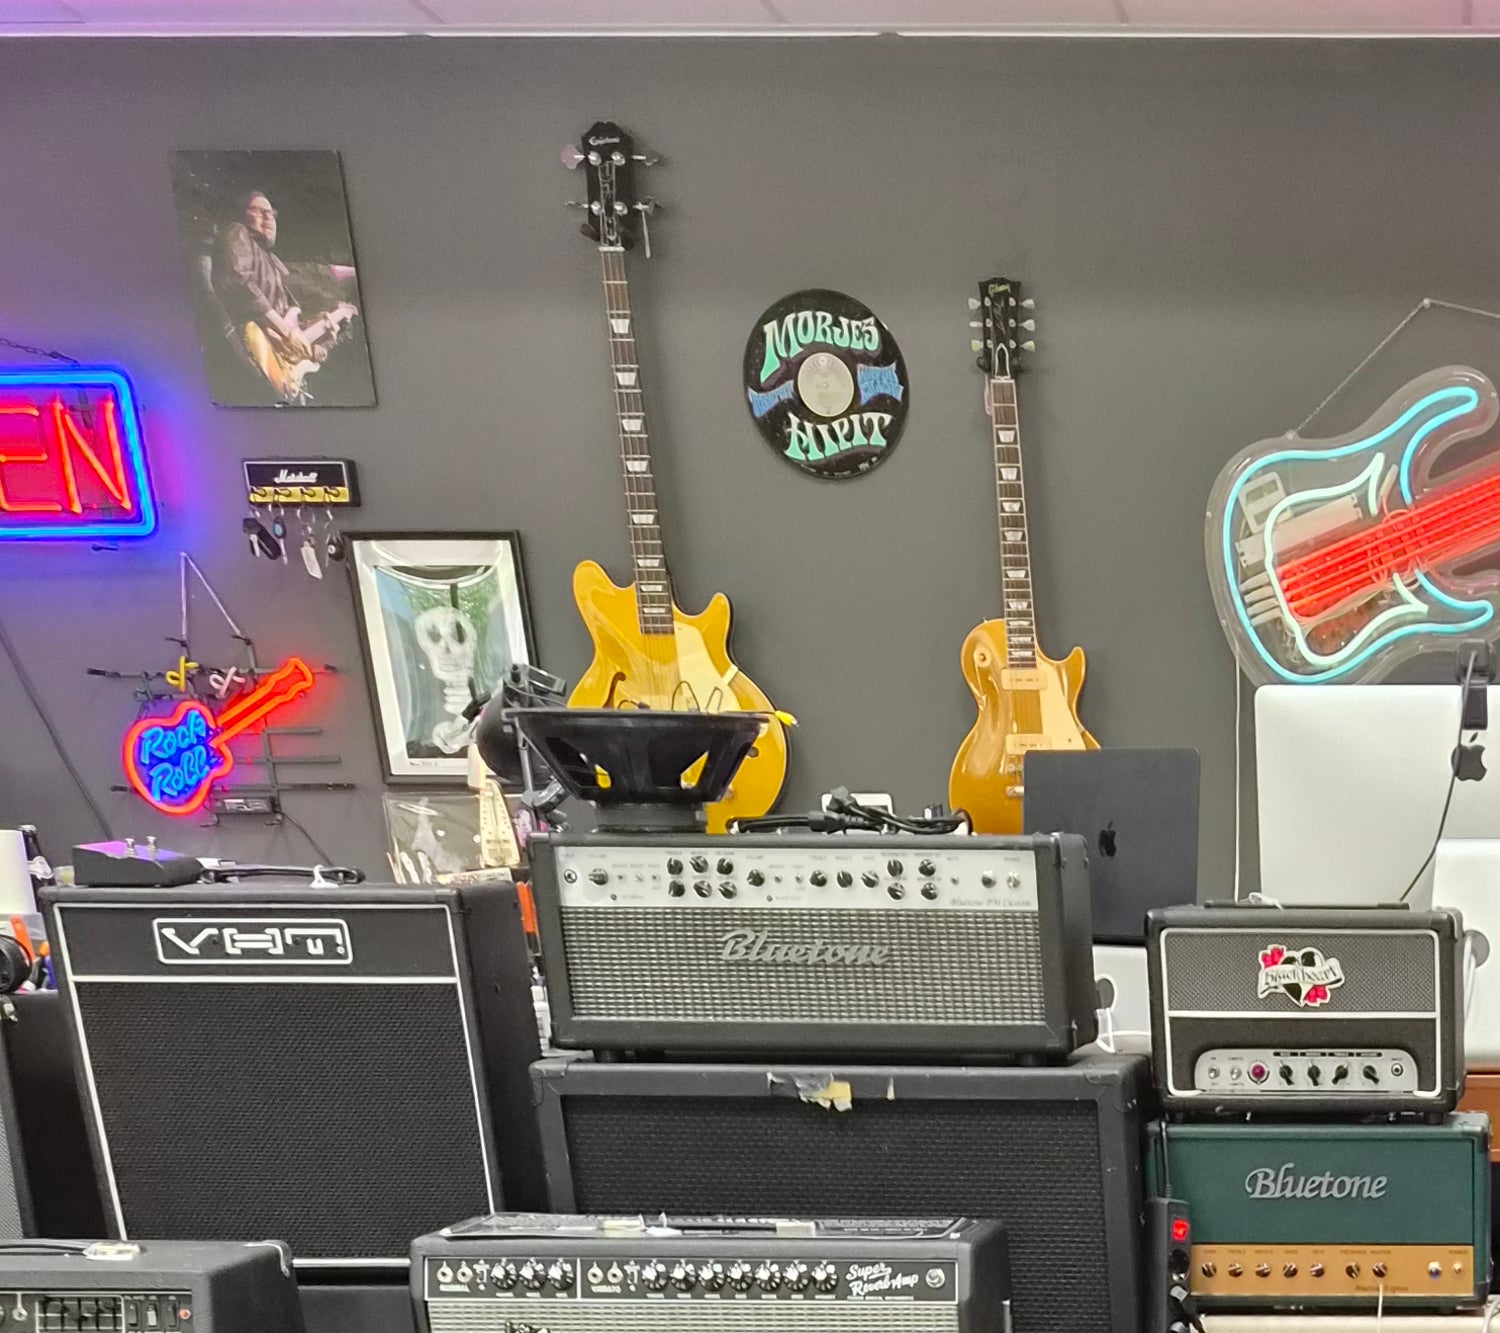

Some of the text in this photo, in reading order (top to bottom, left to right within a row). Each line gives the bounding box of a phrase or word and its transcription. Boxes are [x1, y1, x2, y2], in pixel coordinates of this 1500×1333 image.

[760, 310, 879, 384] MORJES
[140, 709, 206, 766] Rock
[149, 745, 210, 802] Roll
[161, 927, 346, 955] VHT
[718, 929, 891, 966] Bluetone
[1245, 1162, 1388, 1199] Bluetone
[590, 1285, 623, 1294] VIBRATO
[846, 1263, 892, 1281] Super
